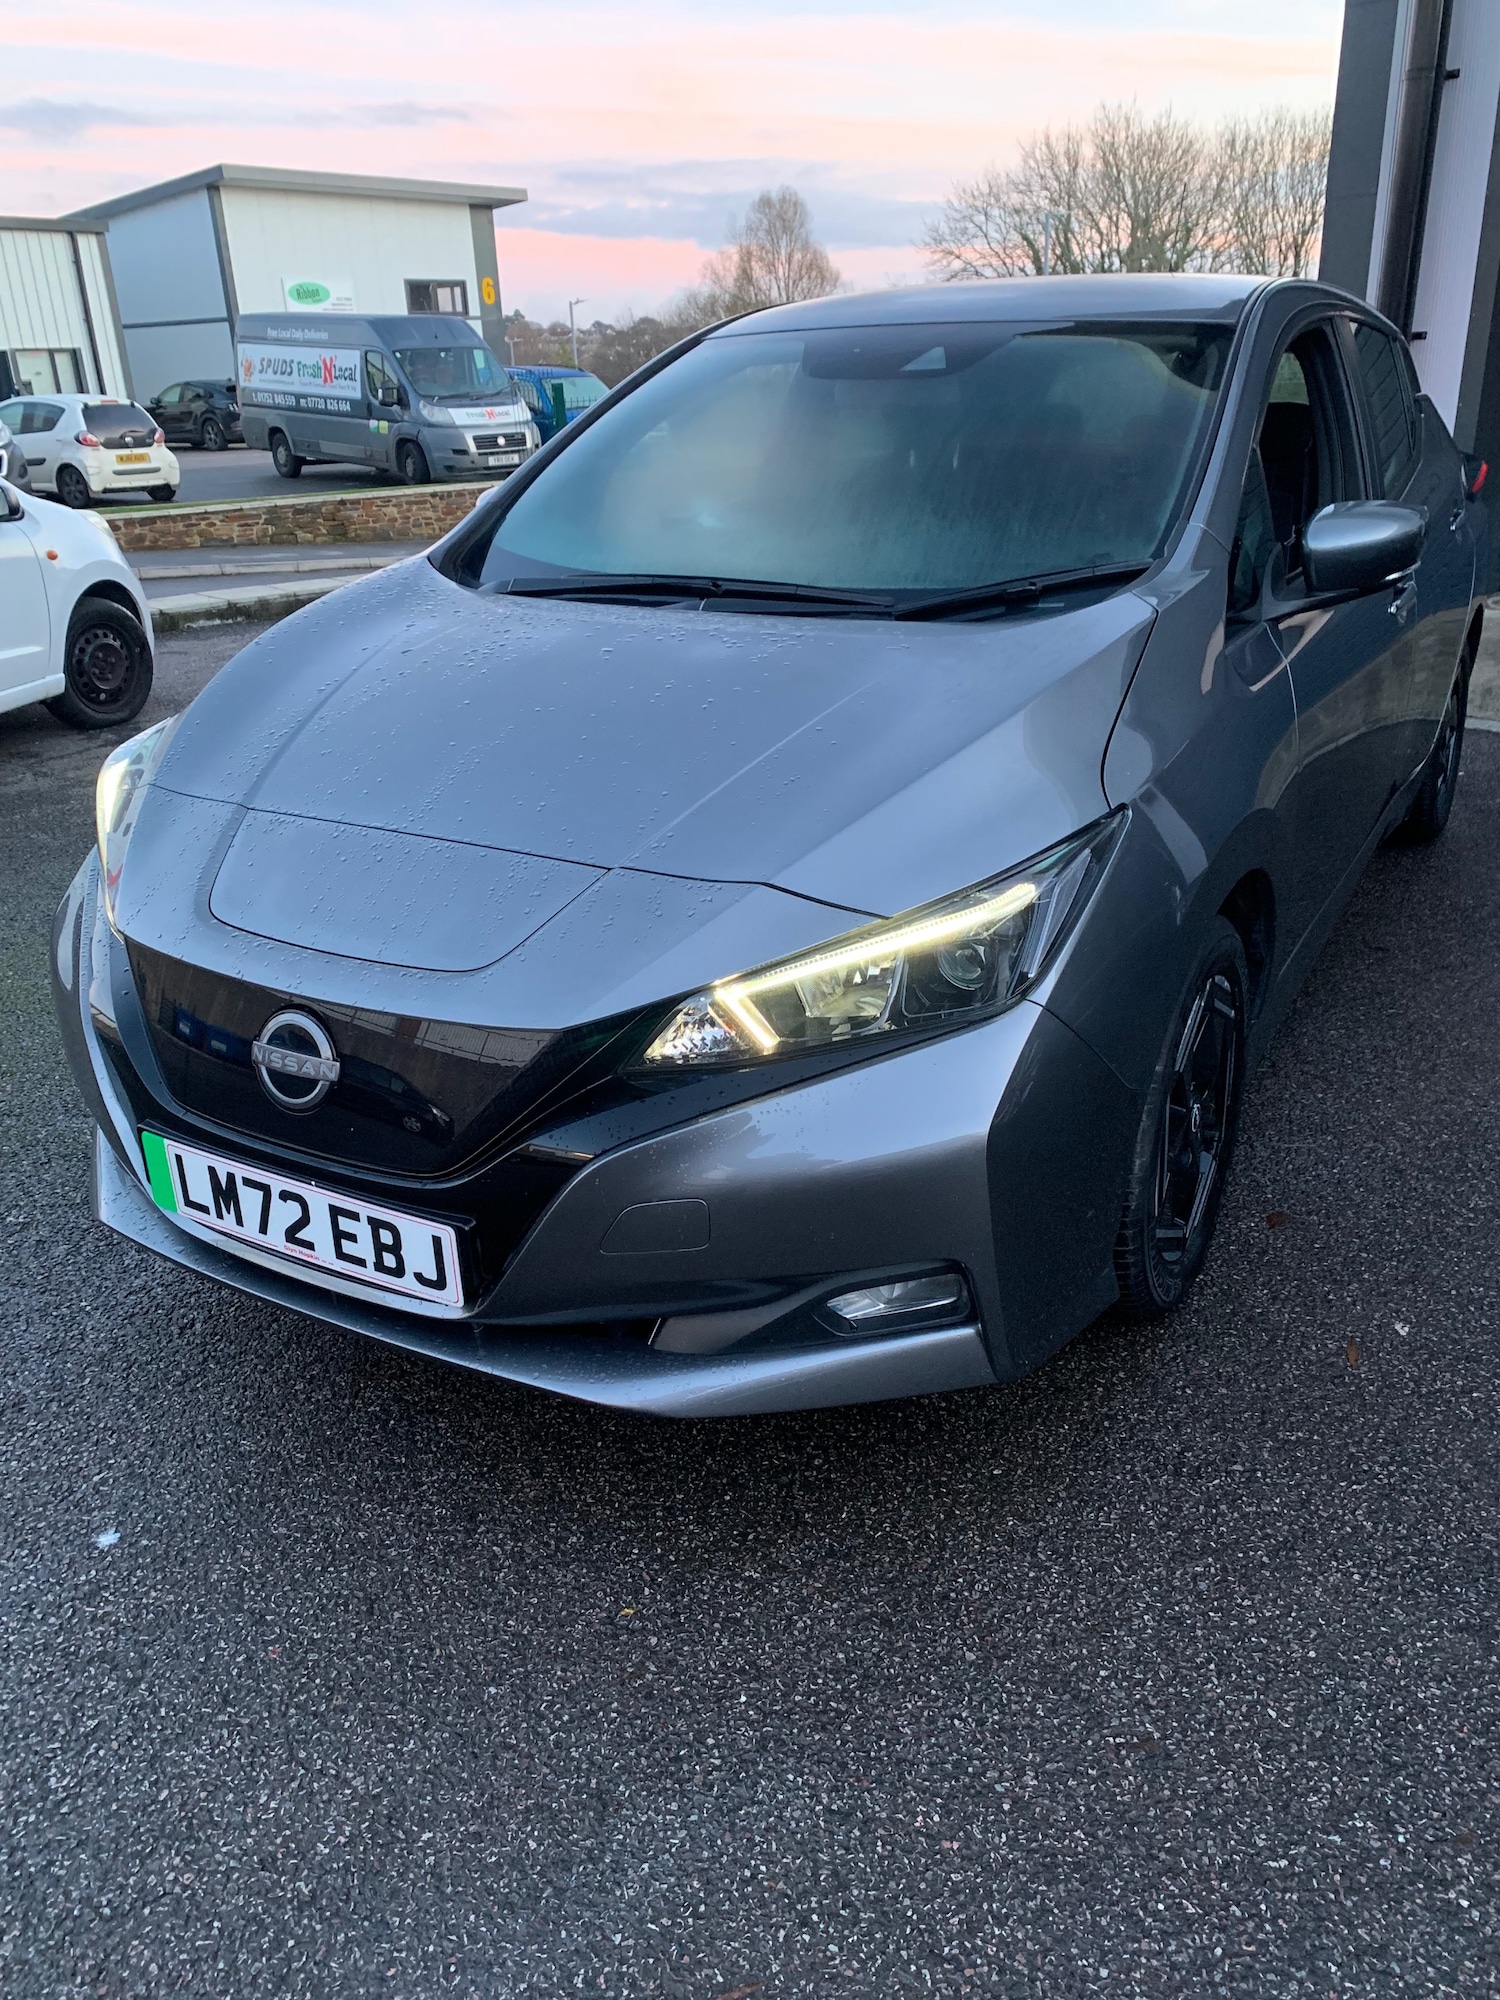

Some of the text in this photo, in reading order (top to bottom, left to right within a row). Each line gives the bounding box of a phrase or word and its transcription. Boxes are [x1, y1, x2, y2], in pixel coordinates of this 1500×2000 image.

[296, 286, 320, 300] Ribbon
[481, 276, 495, 305] 6
[267, 327, 328, 341] Free Local Daily Deliveries
[258, 357, 294, 376] SPUDS
[252, 1045, 338, 1080] NISSAN
[174, 1153, 448, 1291] LM72 EBJ
